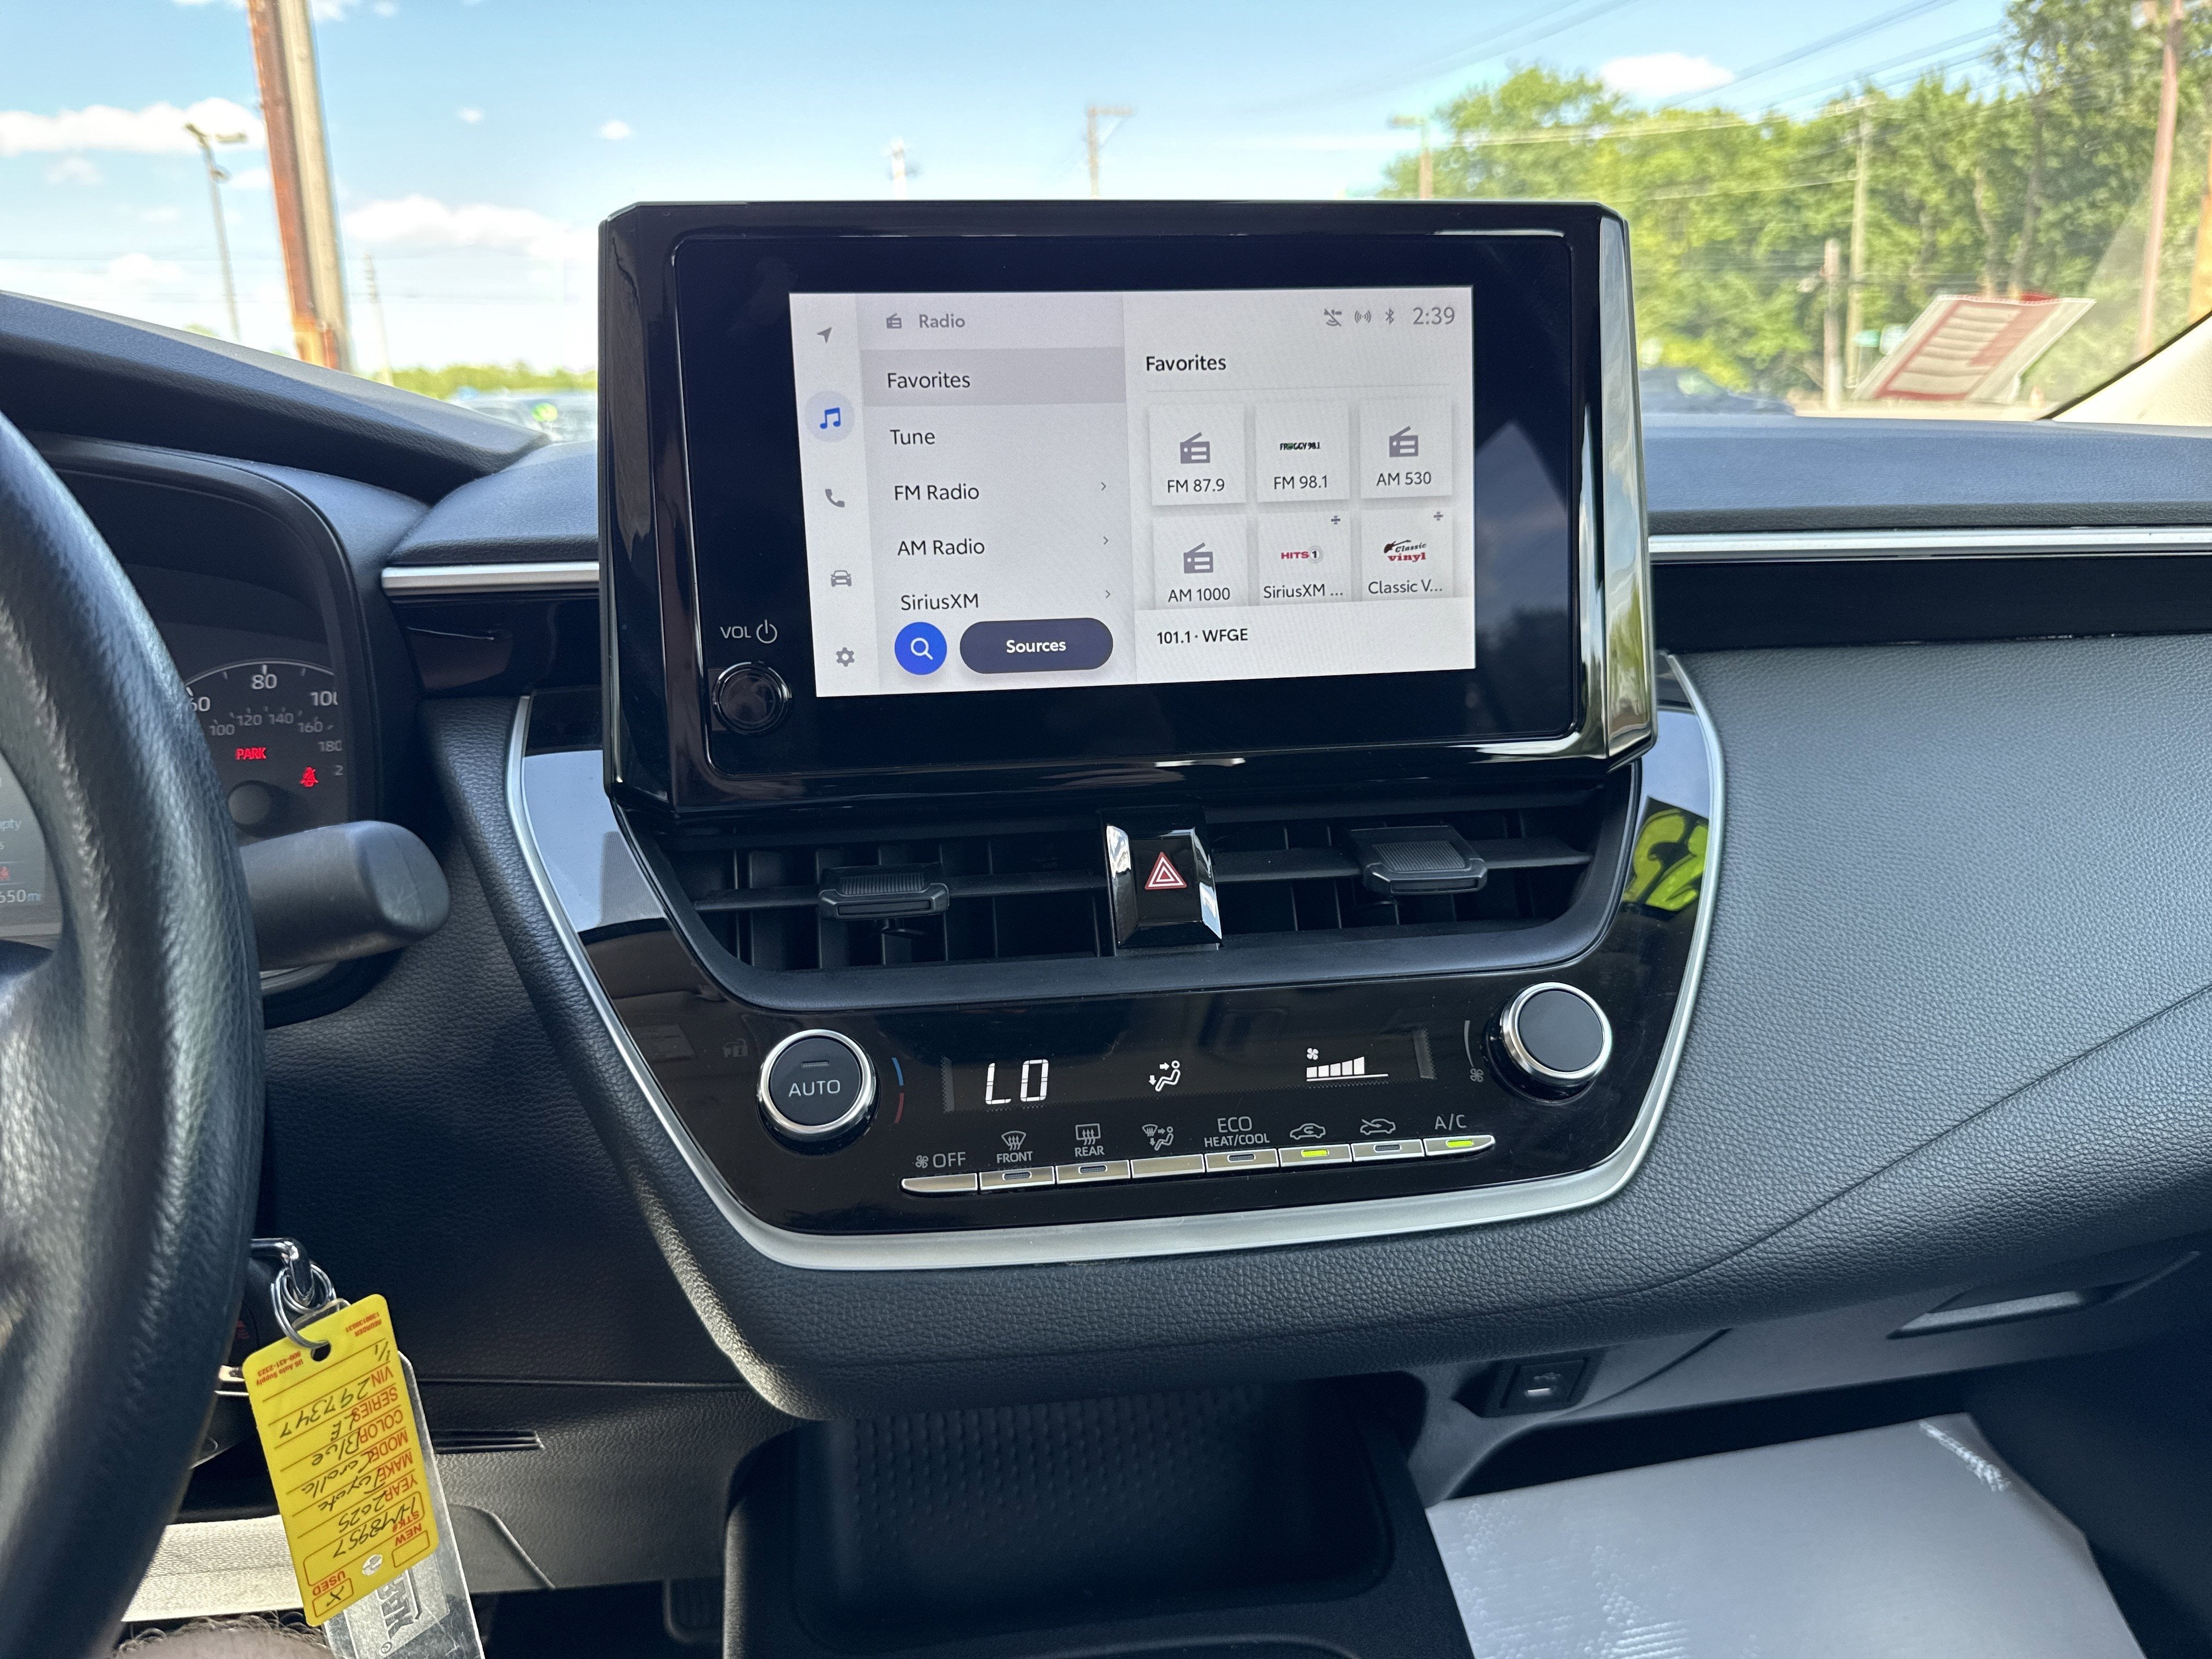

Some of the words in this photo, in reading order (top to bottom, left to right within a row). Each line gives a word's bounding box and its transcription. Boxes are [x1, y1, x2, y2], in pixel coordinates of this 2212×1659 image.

[918, 313, 966, 329] Radio
[1413, 307, 1455, 326] 2:39
[1146, 354, 1227, 373] Favorites
[887, 371, 971, 389] Favorites
[890, 428, 936, 445] Tune
[1166, 479, 1189, 494] FM
[1193, 478, 1226, 493] 87.9
[1273, 476, 1296, 490] FM
[1299, 475, 1328, 490] 98.1
[1376, 472, 1402, 487] AM
[1404, 471, 1432, 486] 530
[894, 485, 921, 501] FM
[927, 483, 980, 500] Radio
[897, 540, 927, 556] AM
[933, 538, 985, 555] Radio
[1280, 551, 1310, 560] HITS
[1312, 550, 1317, 559] 1
[1395, 542, 1427, 553] Classic
[1387, 552, 1427, 563] vinyl
[1167, 589, 1193, 603] AM
[1196, 587, 1231, 602] 1000
[1263, 583, 1325, 599] SiriusXM
[1368, 580, 1418, 595] Classic
[900, 593, 980, 611] SiriusXM
[720, 625, 752, 639] VOL
[1156, 631, 1192, 645] 101.1
[1202, 628, 1249, 644] WFGE
[1006, 639, 1067, 654] Sources
[251, 673, 278, 690] 80
[237, 714, 262, 726] 120
[269, 713, 294, 725] 140
[298, 721, 324, 733] 160
[209, 724, 235, 736] 100
[235, 747, 267, 760] PARK
[788, 1079, 842, 1097] AUTO
[1217, 1116, 1253, 1133] ECO
[1434, 1114, 1467, 1131] A/C
[1204, 1133, 1271, 1148] HEAT/COOL
[996, 1150, 1034, 1164] FRONT
[1075, 1144, 1105, 1158] REAR
[932, 1152, 967, 1169] OFF
[354, 1319, 383, 1337] REORDER
[279, 1363, 294, 1375] Auto
[295, 1359, 304, 1368] US
[256, 1372, 278, 1387] Supply
[370, 1365, 394, 1387] VIN
[279, 1376, 371, 1438] 297347
[352, 1386, 399, 1422] SERIES
[359, 1408, 404, 1443] COLOR
[311, 1426, 361, 1466] Blue
[368, 1430, 409, 1464] MODEL
[379, 1451, 414, 1482] MAKE
[385, 1474, 419, 1502] YEAR
[338, 1489, 388, 1533] 2025
[392, 1510, 420, 1533] STK#
[394, 1523, 422, 1547] NEW
[312, 1570, 346, 1596] USED
